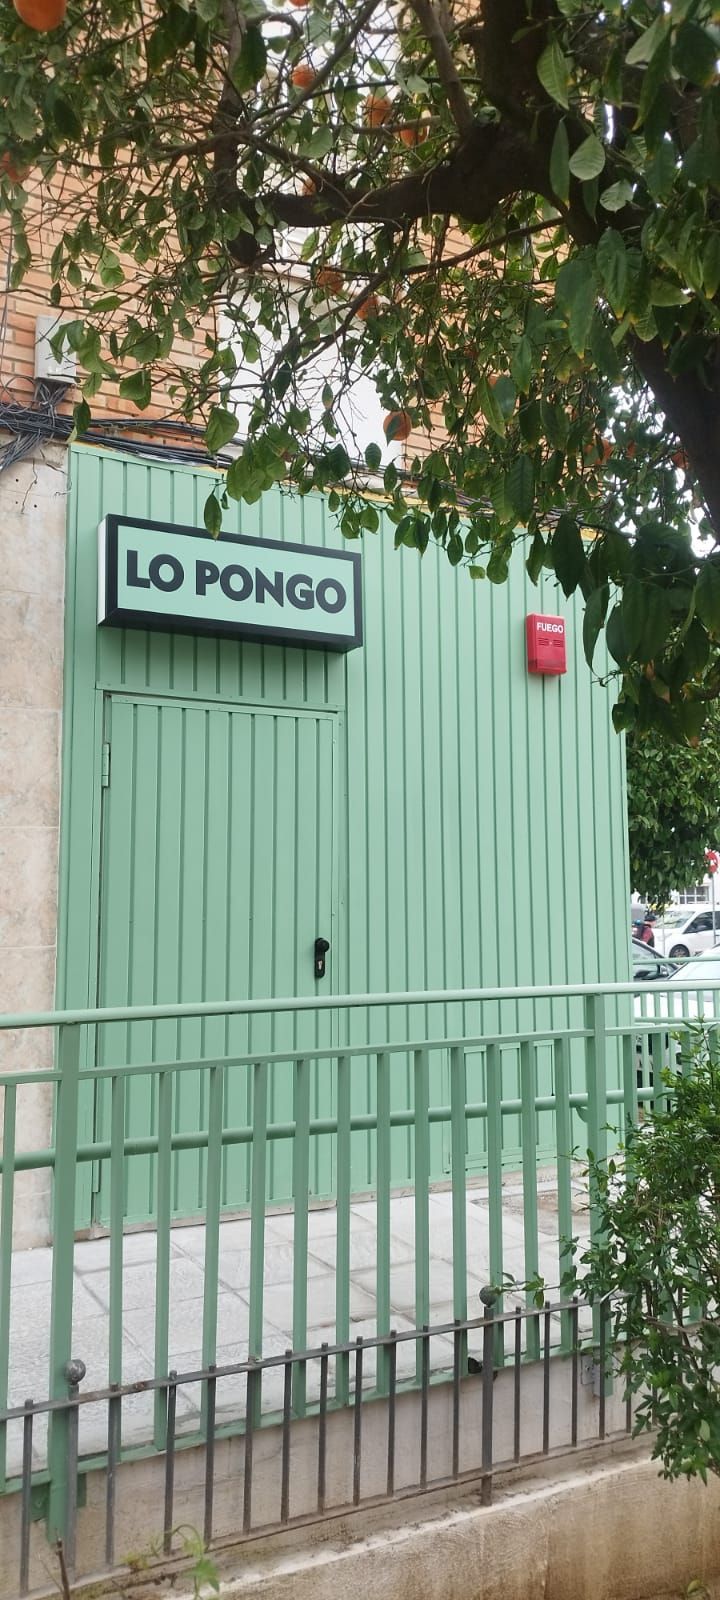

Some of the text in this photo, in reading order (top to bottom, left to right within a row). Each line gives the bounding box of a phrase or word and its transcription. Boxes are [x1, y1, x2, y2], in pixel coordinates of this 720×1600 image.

[126, 549, 347, 614] LO PONGO
[536, 622, 564, 633] FUEGO
